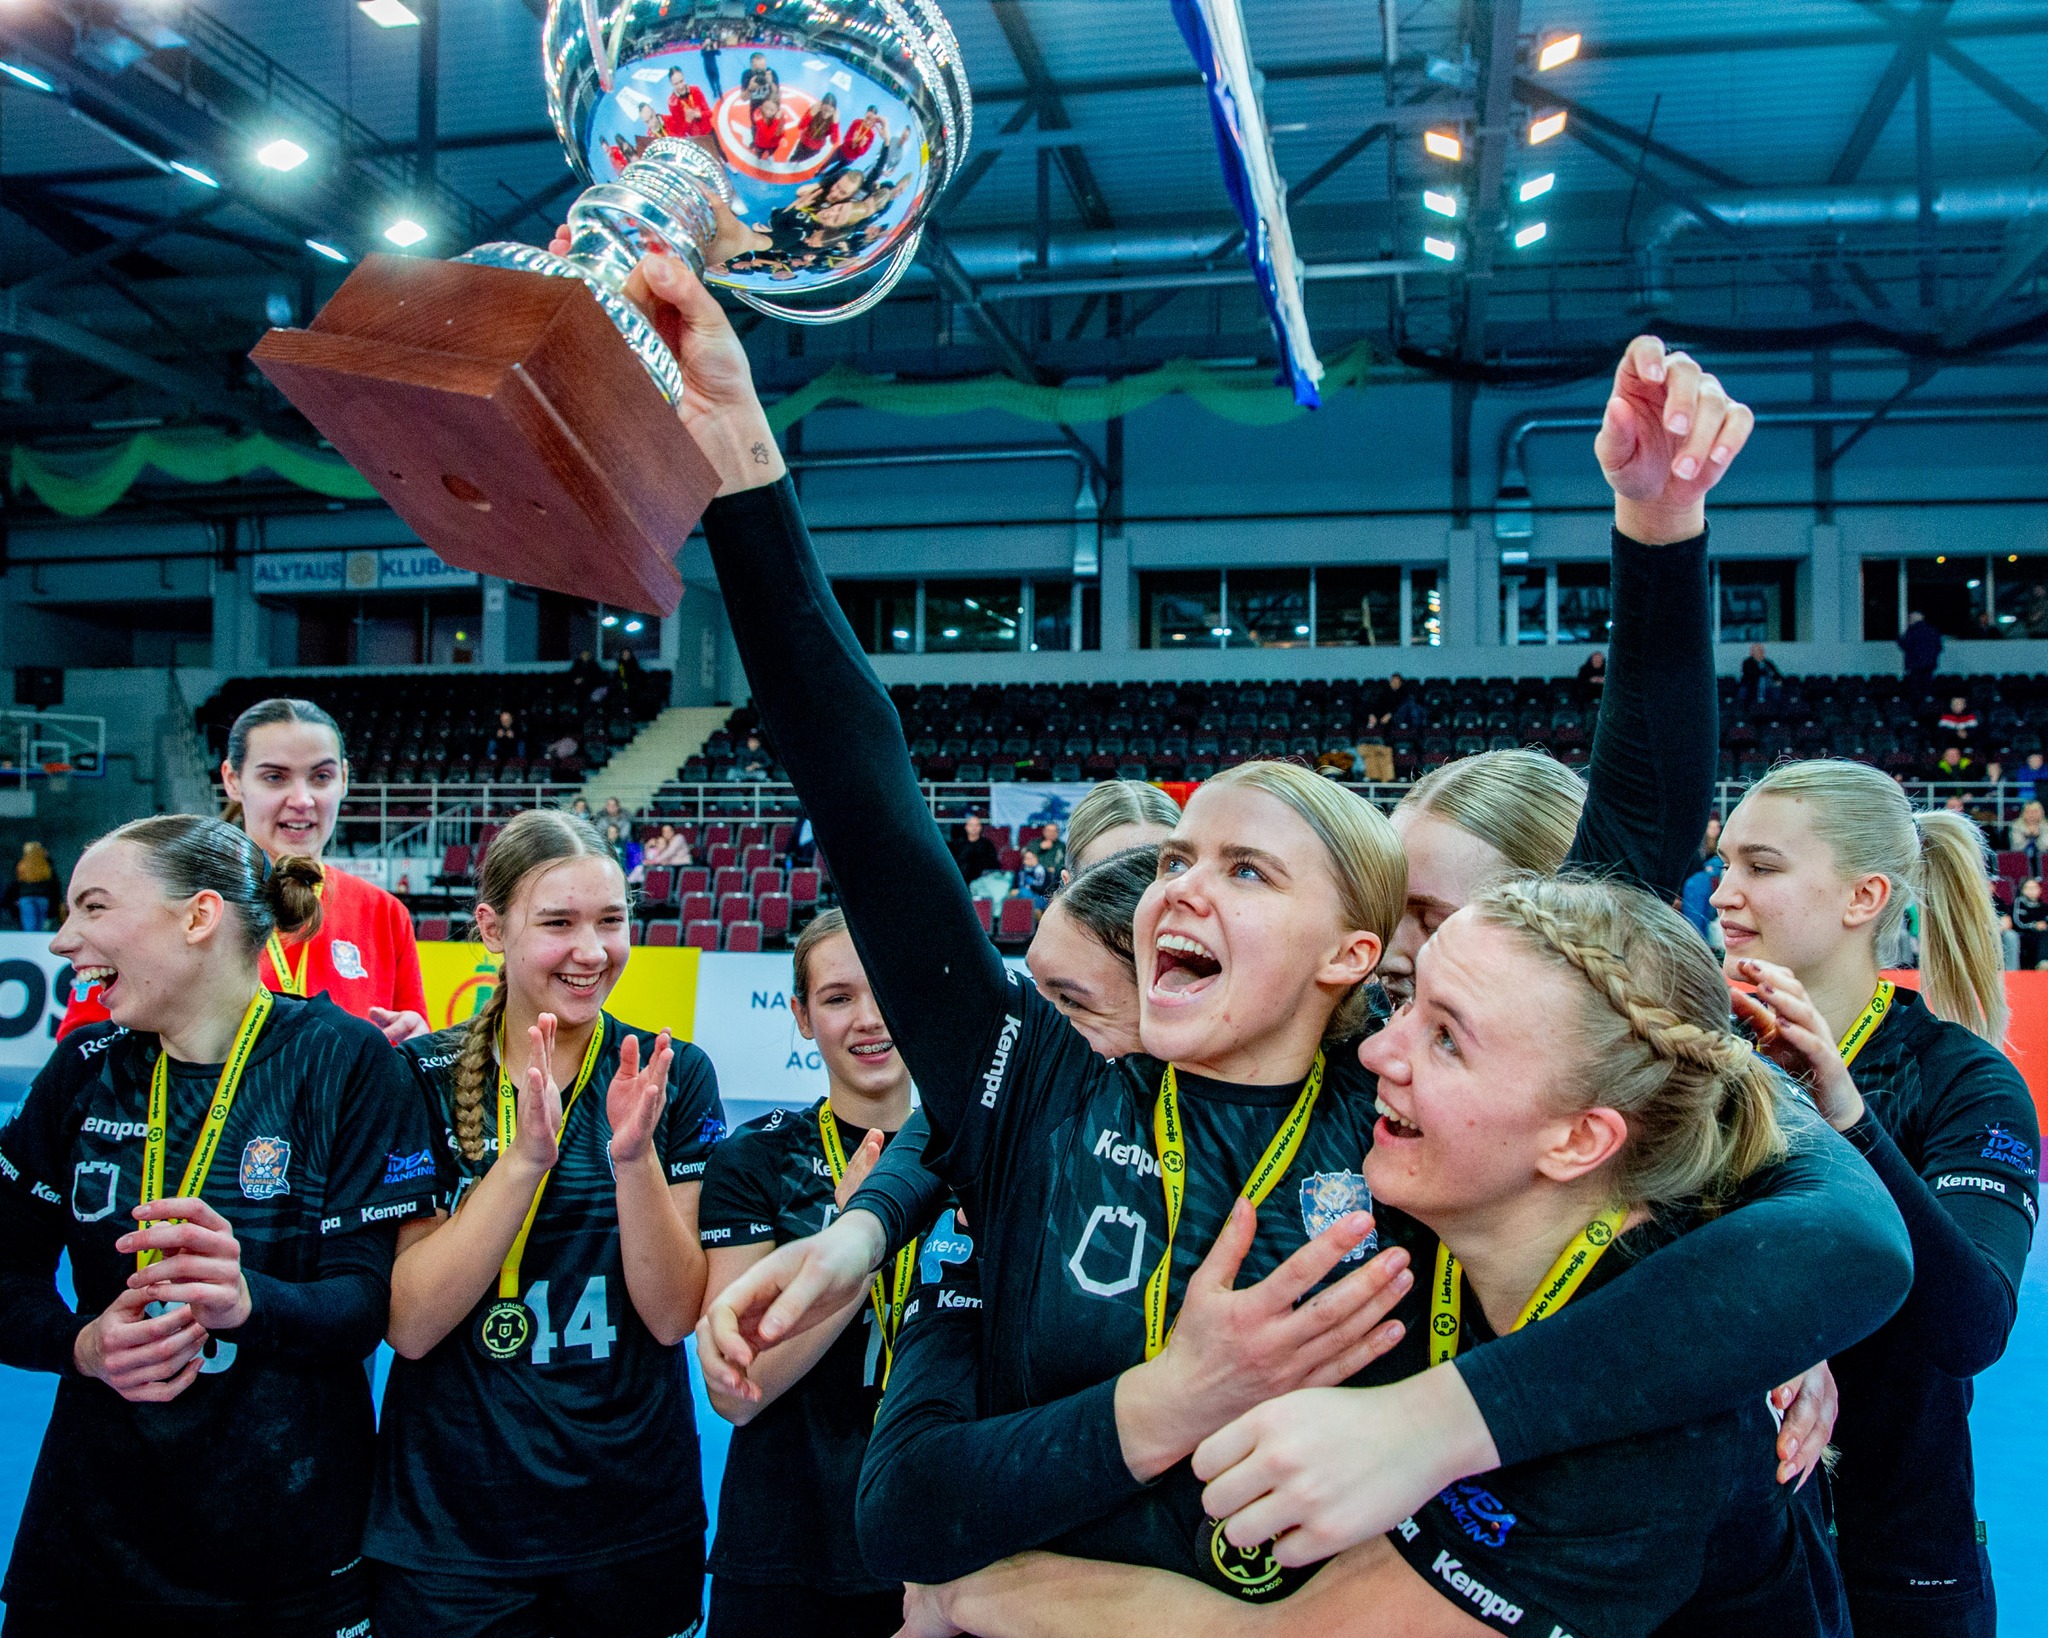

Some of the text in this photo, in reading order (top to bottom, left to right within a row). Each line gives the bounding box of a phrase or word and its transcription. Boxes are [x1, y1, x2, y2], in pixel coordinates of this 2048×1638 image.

[382, 557, 472, 577] KLUBA
[980, 1013, 1022, 1109] Kempa
[81, 1116, 148, 1141] empa
[1246, 1161, 1273, 1200] ietuvos
[1936, 1174, 2006, 1194] Kempa
[361, 1201, 417, 1223] Kempa
[700, 1228, 731, 1243] empa
[1543, 1250, 1587, 1301] federacija
[1432, 1549, 1524, 1625] Kempa
